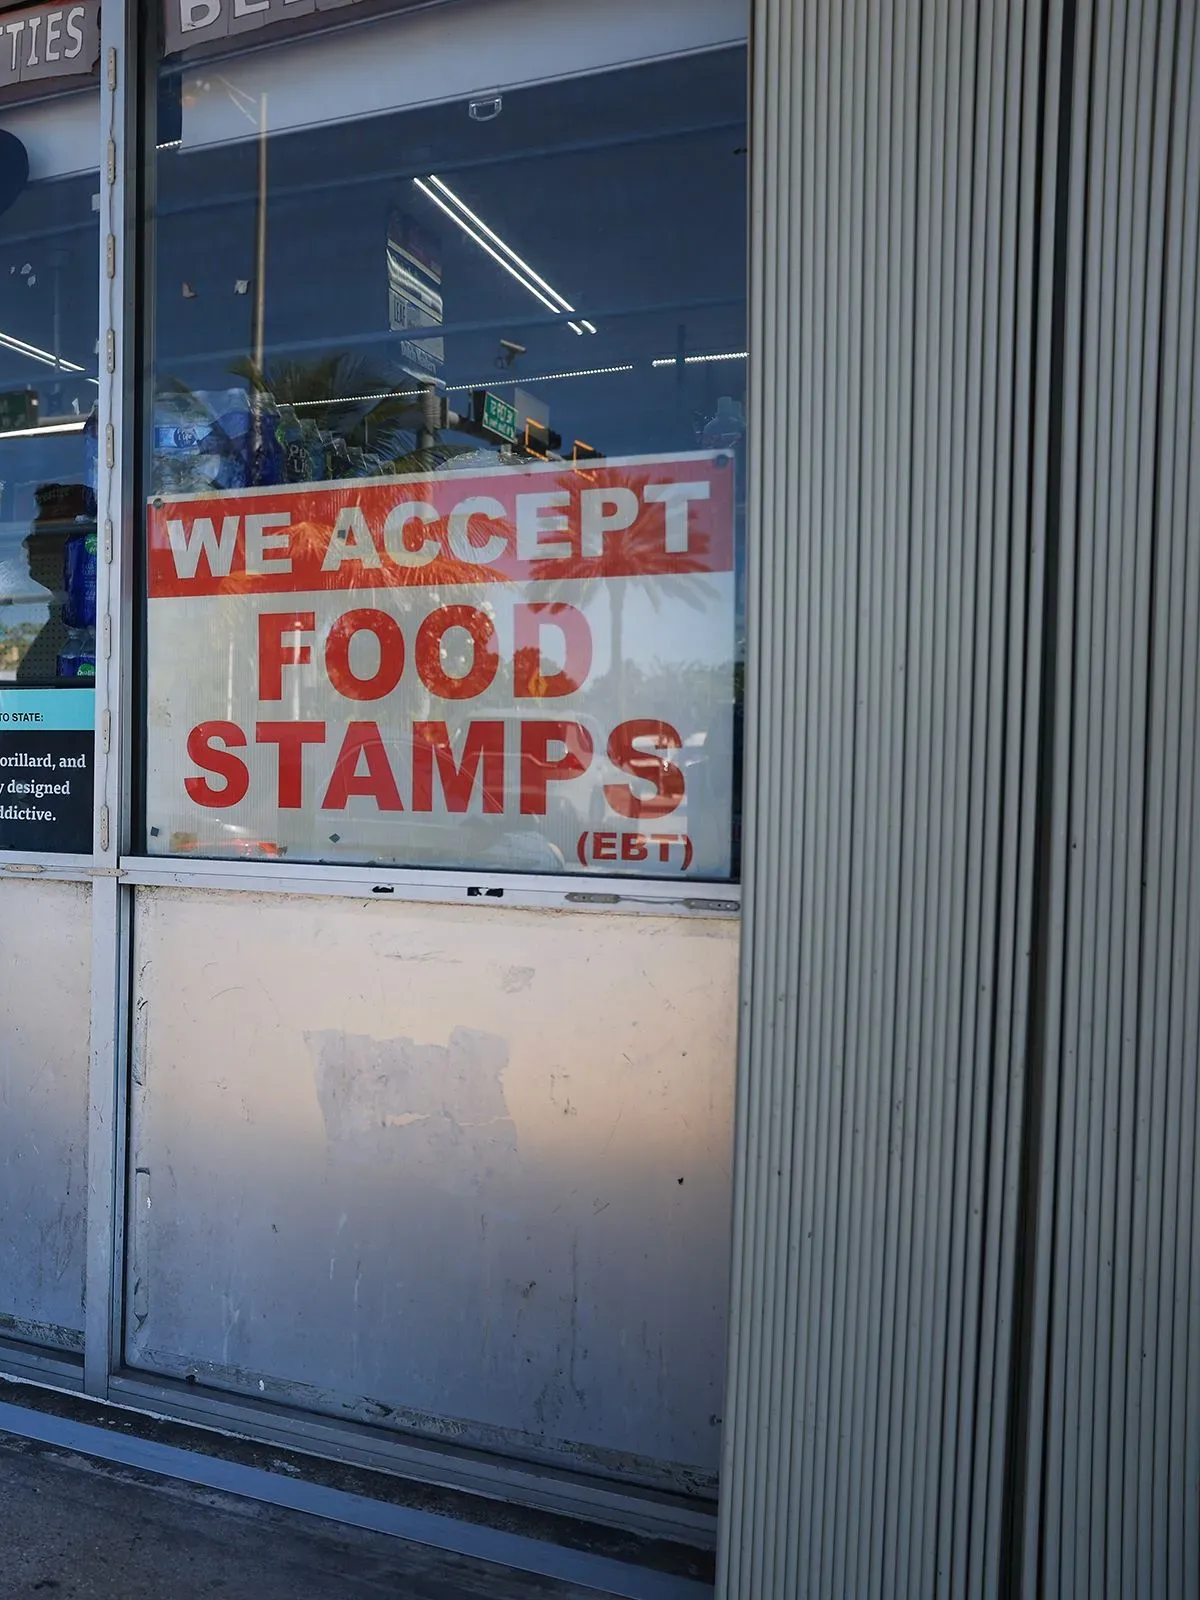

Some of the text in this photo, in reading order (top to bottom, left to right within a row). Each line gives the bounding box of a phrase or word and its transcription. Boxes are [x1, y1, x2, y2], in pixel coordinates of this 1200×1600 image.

[165, 480, 711, 580] WE ACCEPT
[256, 601, 594, 702] FOOD
[12, 712, 44, 722] STATE:
[59, 753, 87, 768] and
[182, 718, 688, 821] STAMPS
[7, 779, 71, 798] designed
[576, 830, 693, 871] (EBT)
